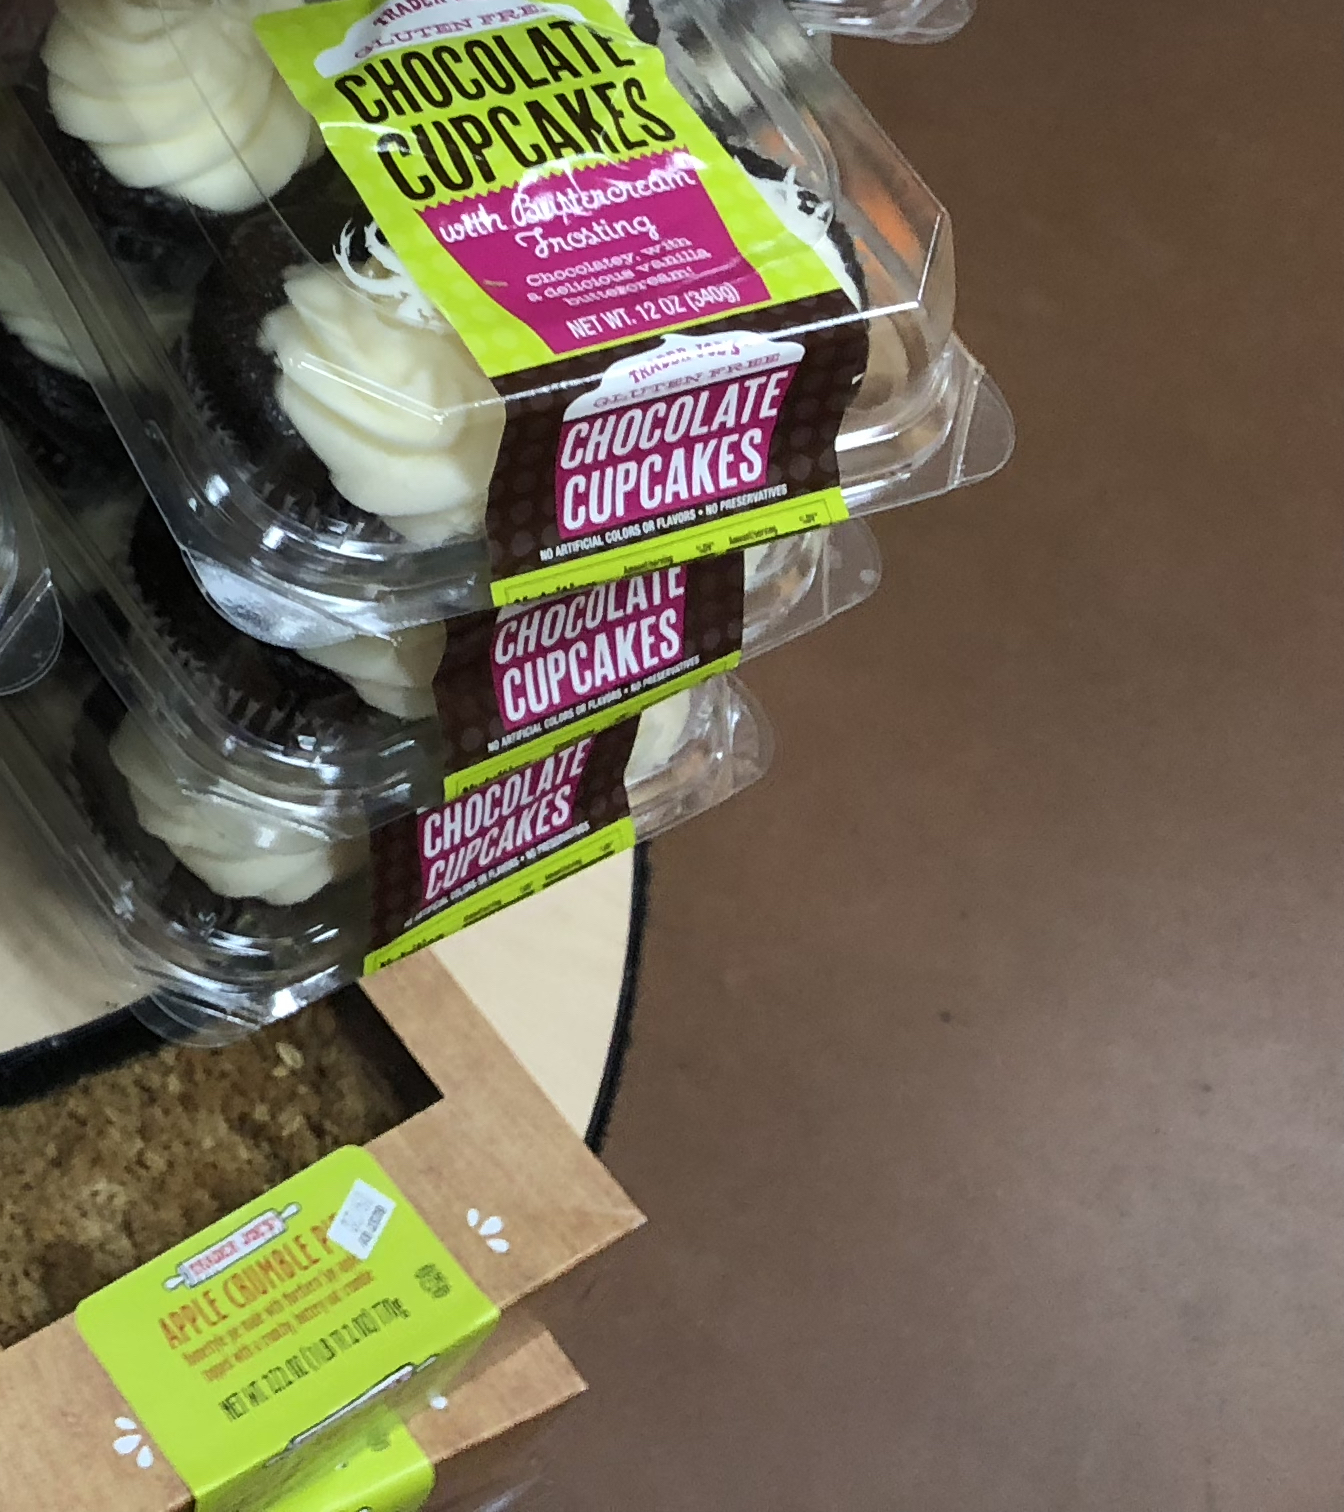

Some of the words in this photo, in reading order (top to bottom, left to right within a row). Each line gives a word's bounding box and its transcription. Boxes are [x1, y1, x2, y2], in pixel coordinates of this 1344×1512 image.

[334, 19, 634, 124] CHOCOLATE
[355, 17, 472, 58] GLUTEN
[378, 78, 676, 200] CUPCAKES
[439, 205, 508, 243] with
[515, 215, 660, 258] Frosting
[635, 247, 712, 272] vanilla
[566, 315, 602, 339] NET
[600, 308, 637, 331] WT.
[635, 299, 660, 322] 12
[660, 295, 687, 316] OZ
[686, 283, 741, 313] (340g)
[708, 352, 780, 378] FREE
[561, 371, 789, 469] CHOCOLATE
[539, 548, 553, 562] NO
[555, 532, 604, 558] ARTIFICIAL
[605, 522, 641, 544] COLORS
[642, 520, 656, 534] OR
[656, 509, 696, 530] FLAVORS
[705, 501, 719, 516] NO
[719, 483, 788, 512] PRESERVATIVES
[562, 428, 763, 530] CUPCAKES
[493, 566, 685, 665] CHOCOLATE
[502, 608, 680, 722] CUPCAKES
[423, 737, 593, 858] CHOCOLATE
[425, 785, 571, 900] CUPCAKES
[158, 1289, 229, 1350] APPLE
[222, 1234, 321, 1309] CRUMBLE
